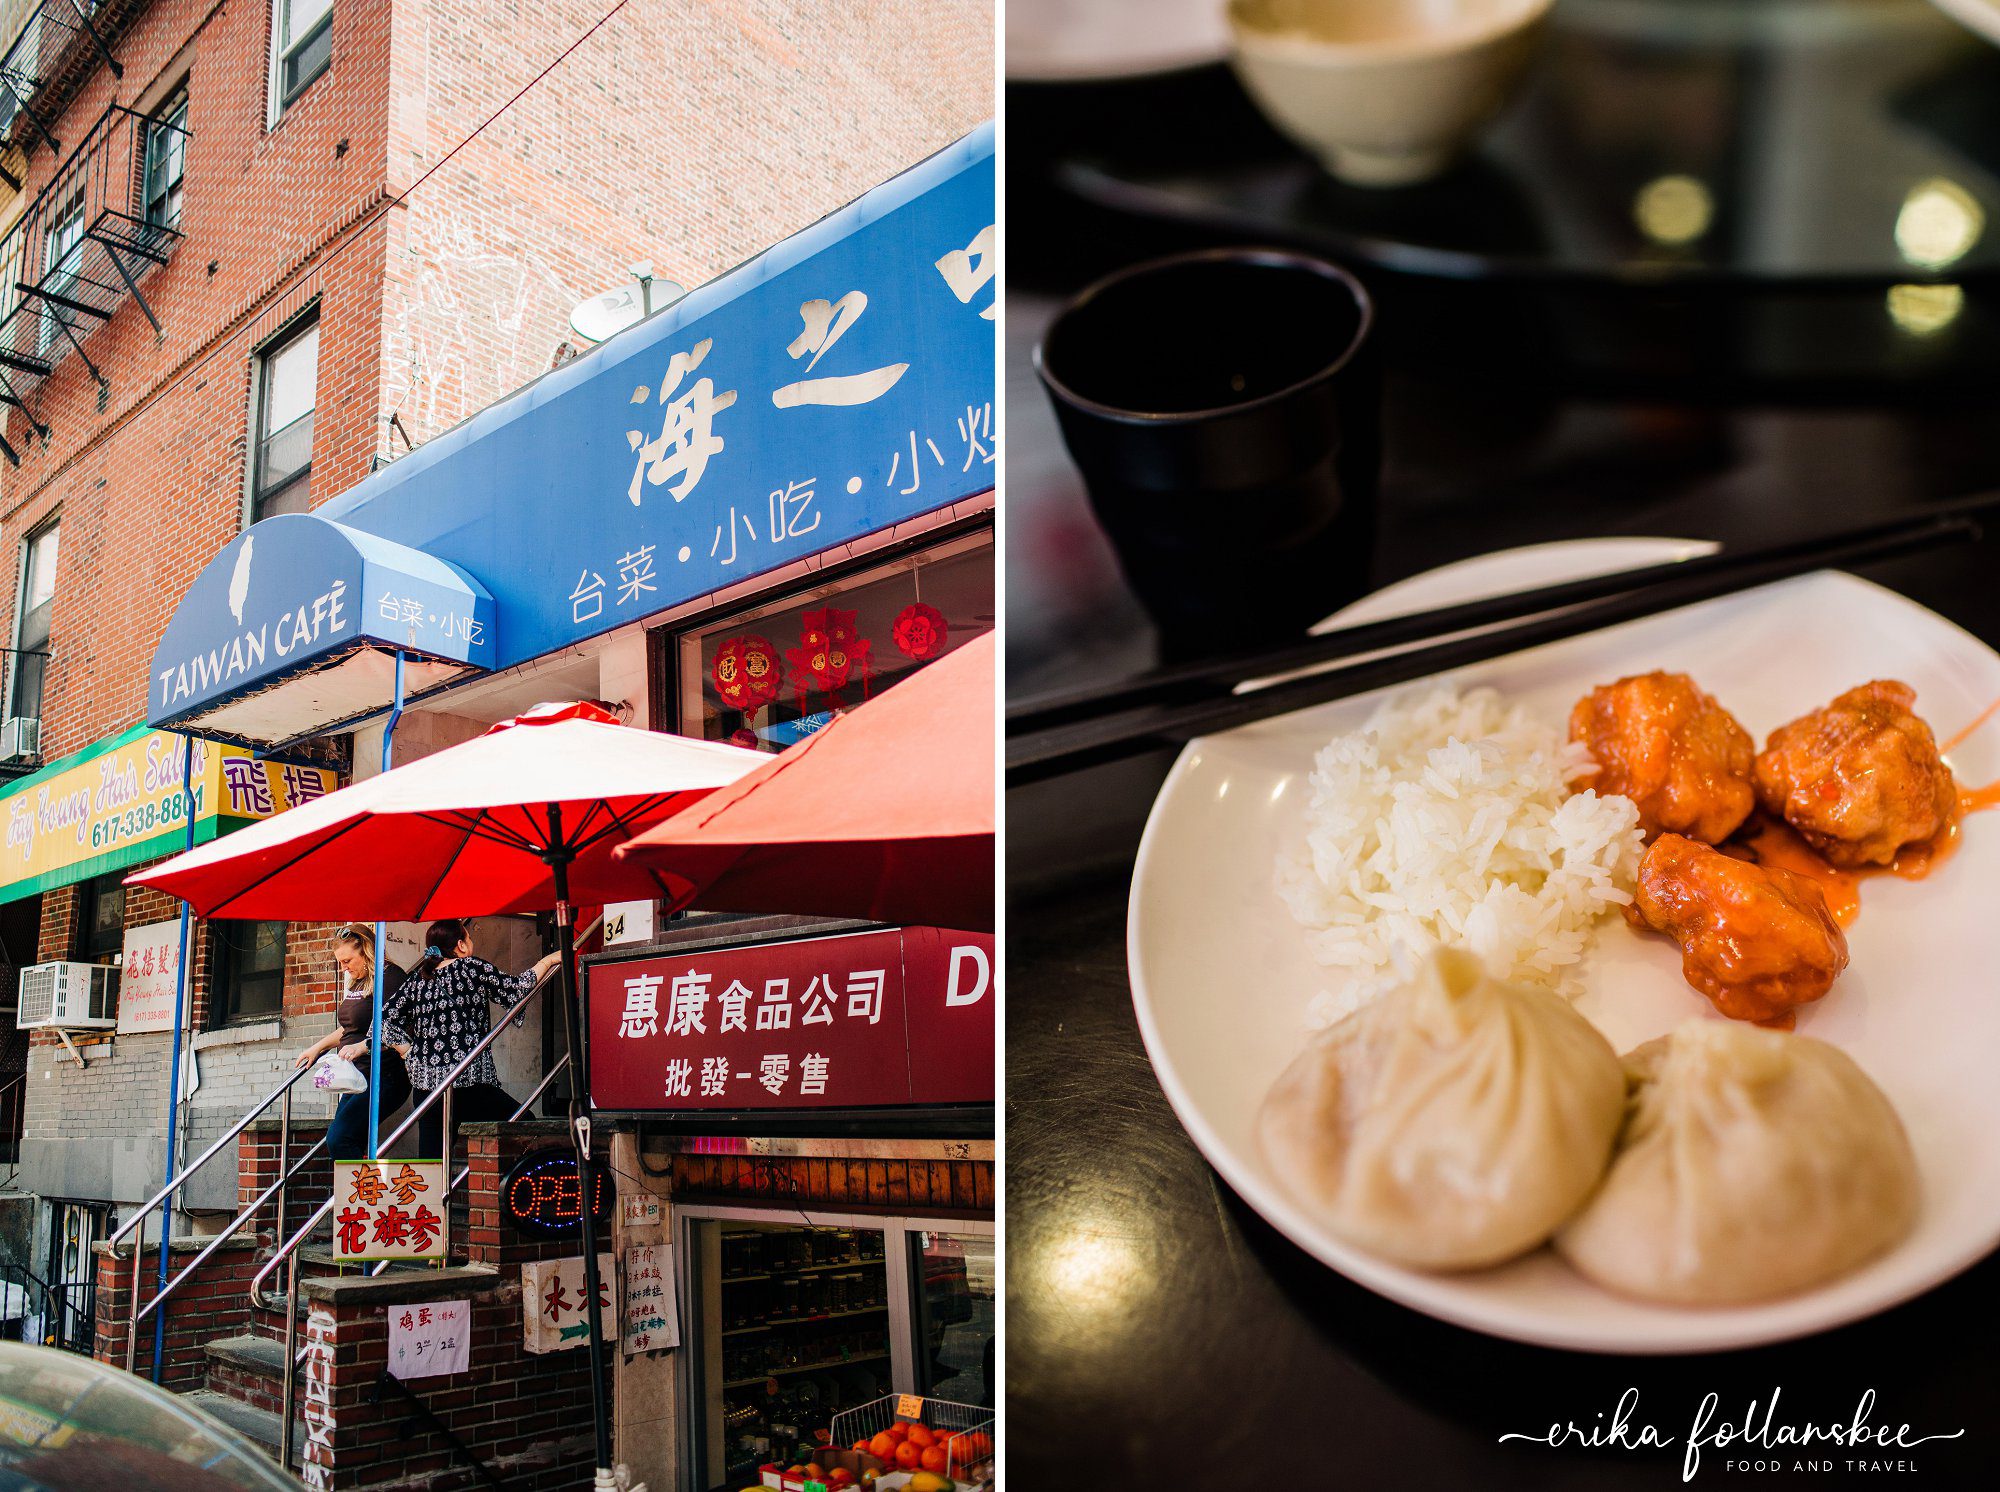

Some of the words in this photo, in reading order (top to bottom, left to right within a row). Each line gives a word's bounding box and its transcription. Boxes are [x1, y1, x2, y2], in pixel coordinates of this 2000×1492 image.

[159, 621, 269, 708] TAIWAN
[38, 784, 90, 844] Young
[96, 754, 139, 812] Hair
[605, 914, 625, 942] 34
[617, 968, 886, 1039] 惠康食品公司
[347, 1163, 430, 1206] 海参
[336, 1204, 442, 1255] 花旗参
[399, 1307, 433, 1332] 鸡蛋
